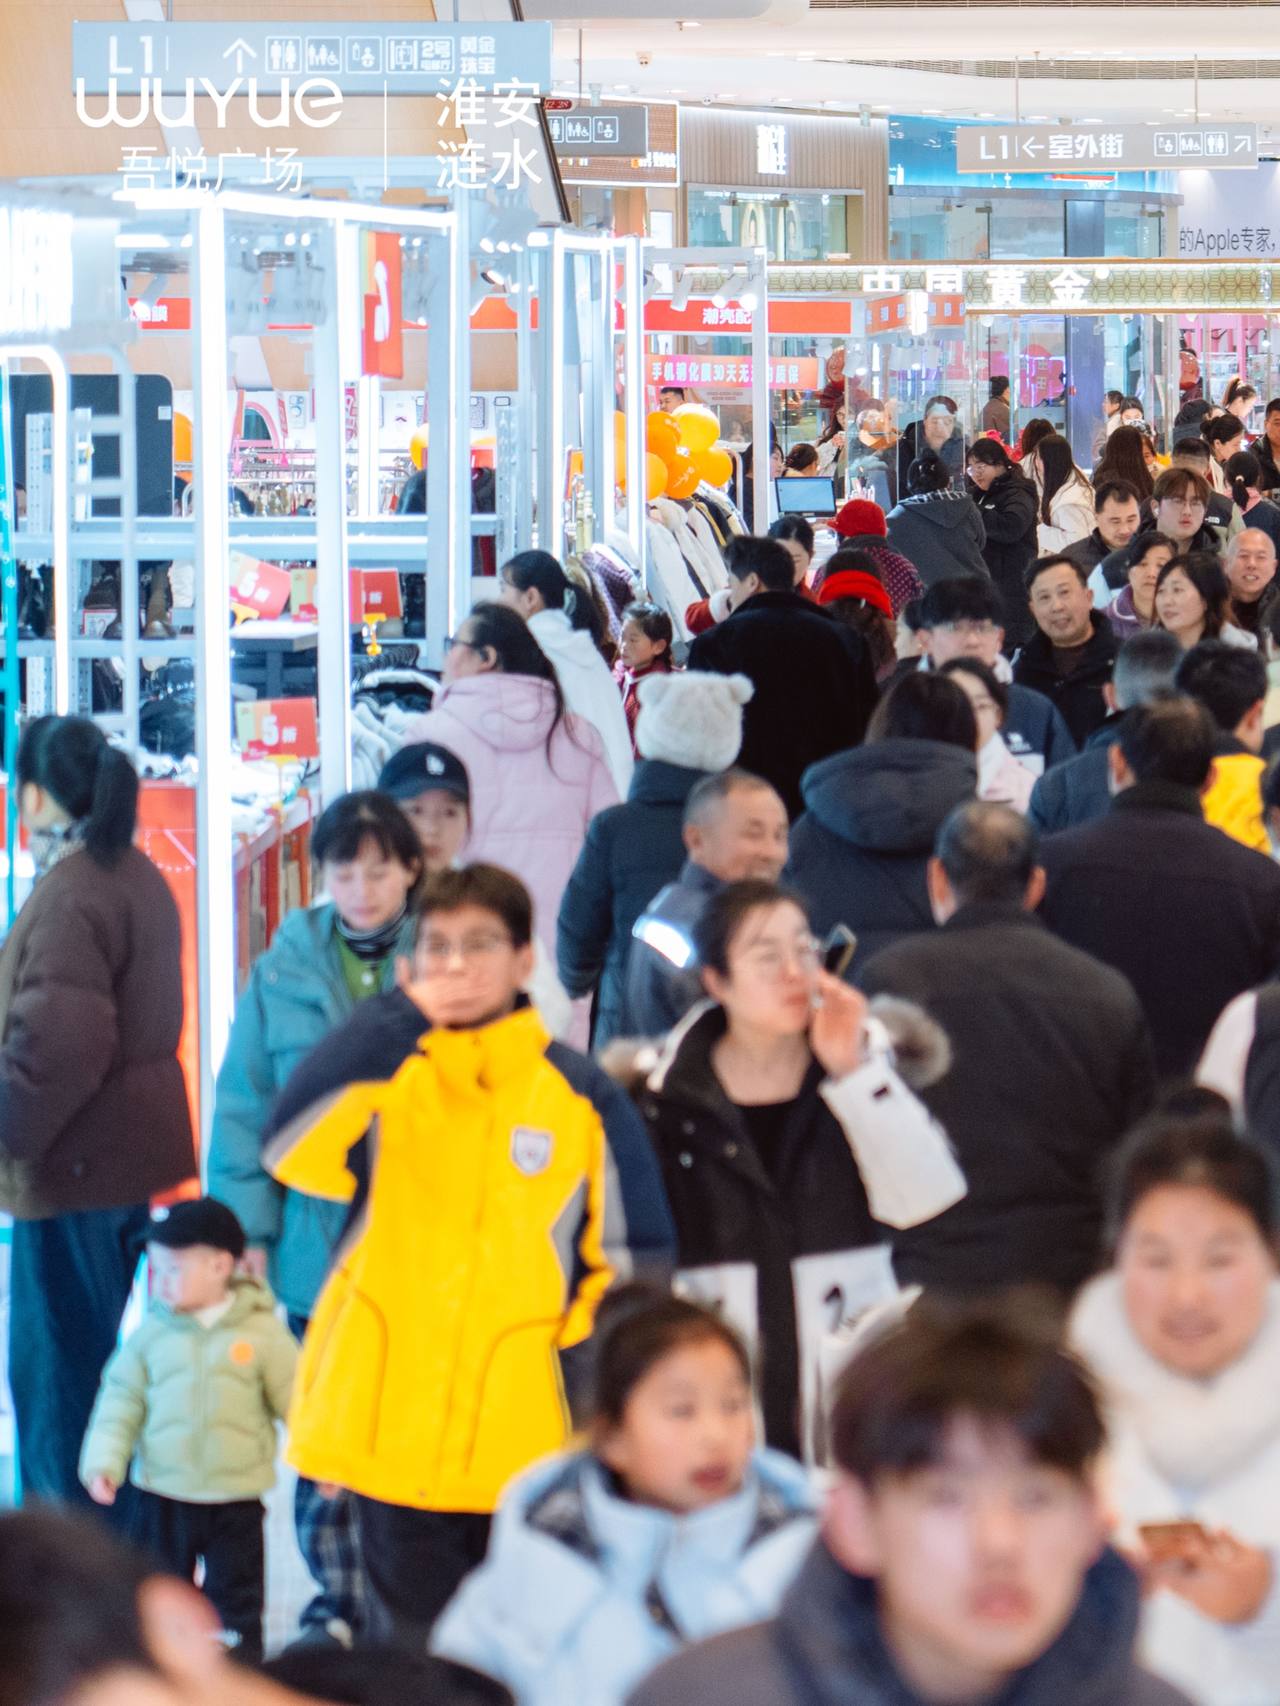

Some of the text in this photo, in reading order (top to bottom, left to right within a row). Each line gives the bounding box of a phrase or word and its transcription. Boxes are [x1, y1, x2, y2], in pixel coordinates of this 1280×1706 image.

[109, 36, 153, 74] L1
[422, 40, 451, 58] 2号
[460, 36, 496, 54] 黄金
[460, 57, 496, 75] 珠宝
[979, 134, 1124, 160] L1 室外街
[862, 268, 1092, 308] 中国黄金
[651, 361, 800, 385] 手机钢化膜30天无质保
